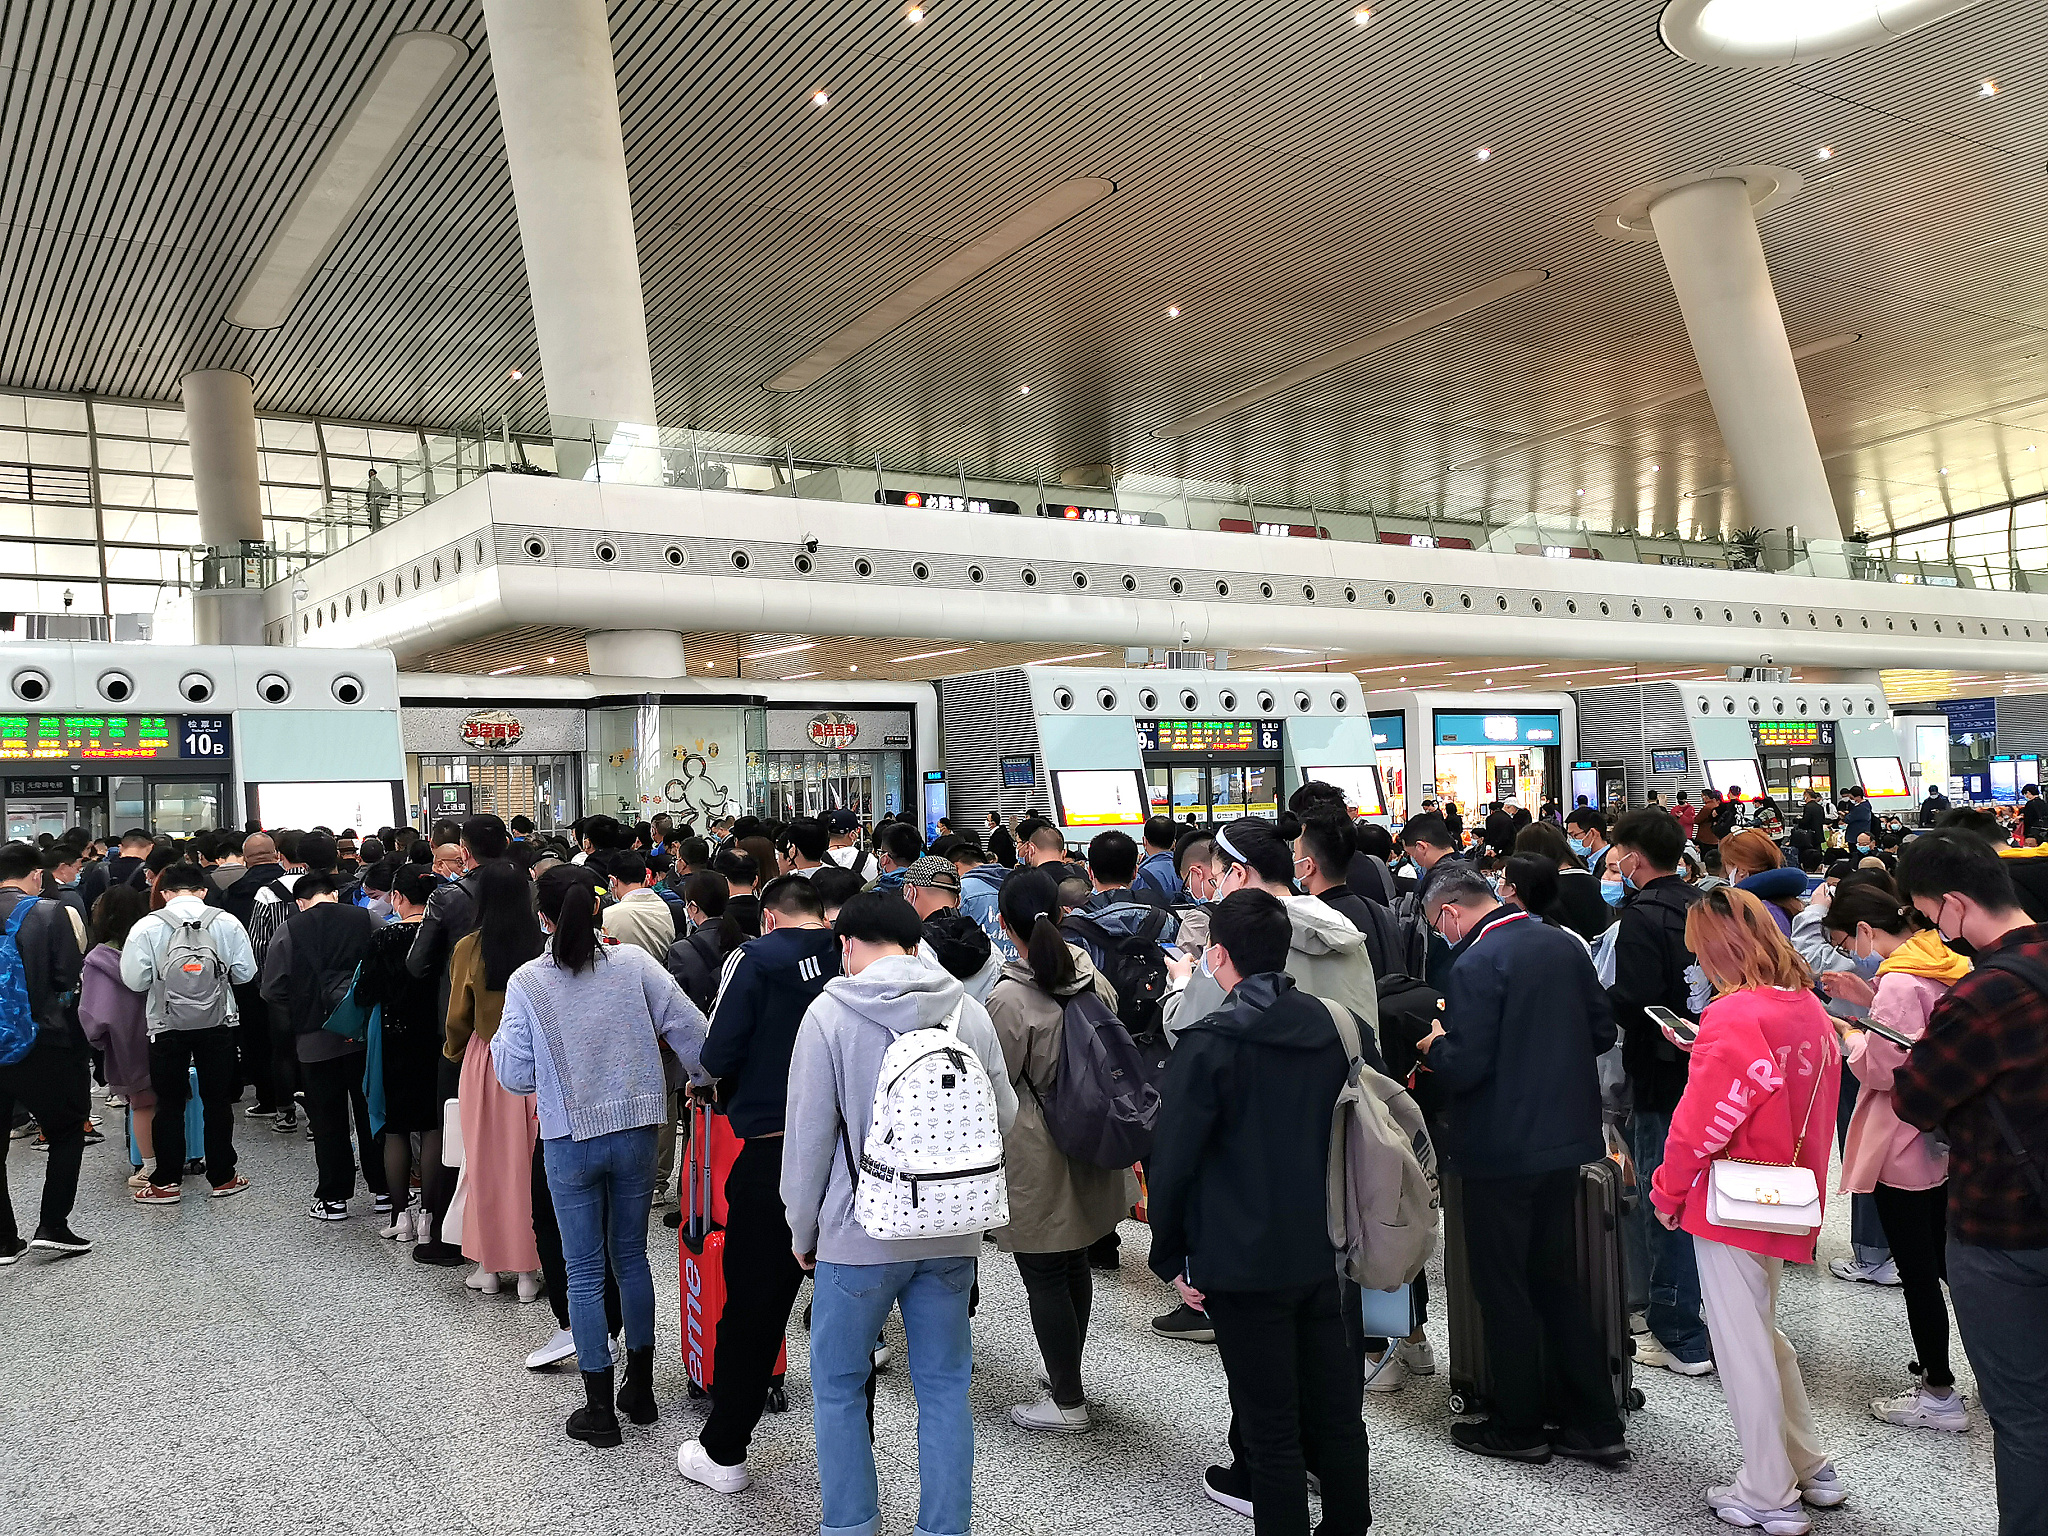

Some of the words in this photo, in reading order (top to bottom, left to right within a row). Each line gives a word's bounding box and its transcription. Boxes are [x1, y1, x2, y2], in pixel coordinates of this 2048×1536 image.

[185, 734, 224, 755] 10B
[1262, 732, 1278, 748] 8B
[435, 803, 466, 811] 人工通道
